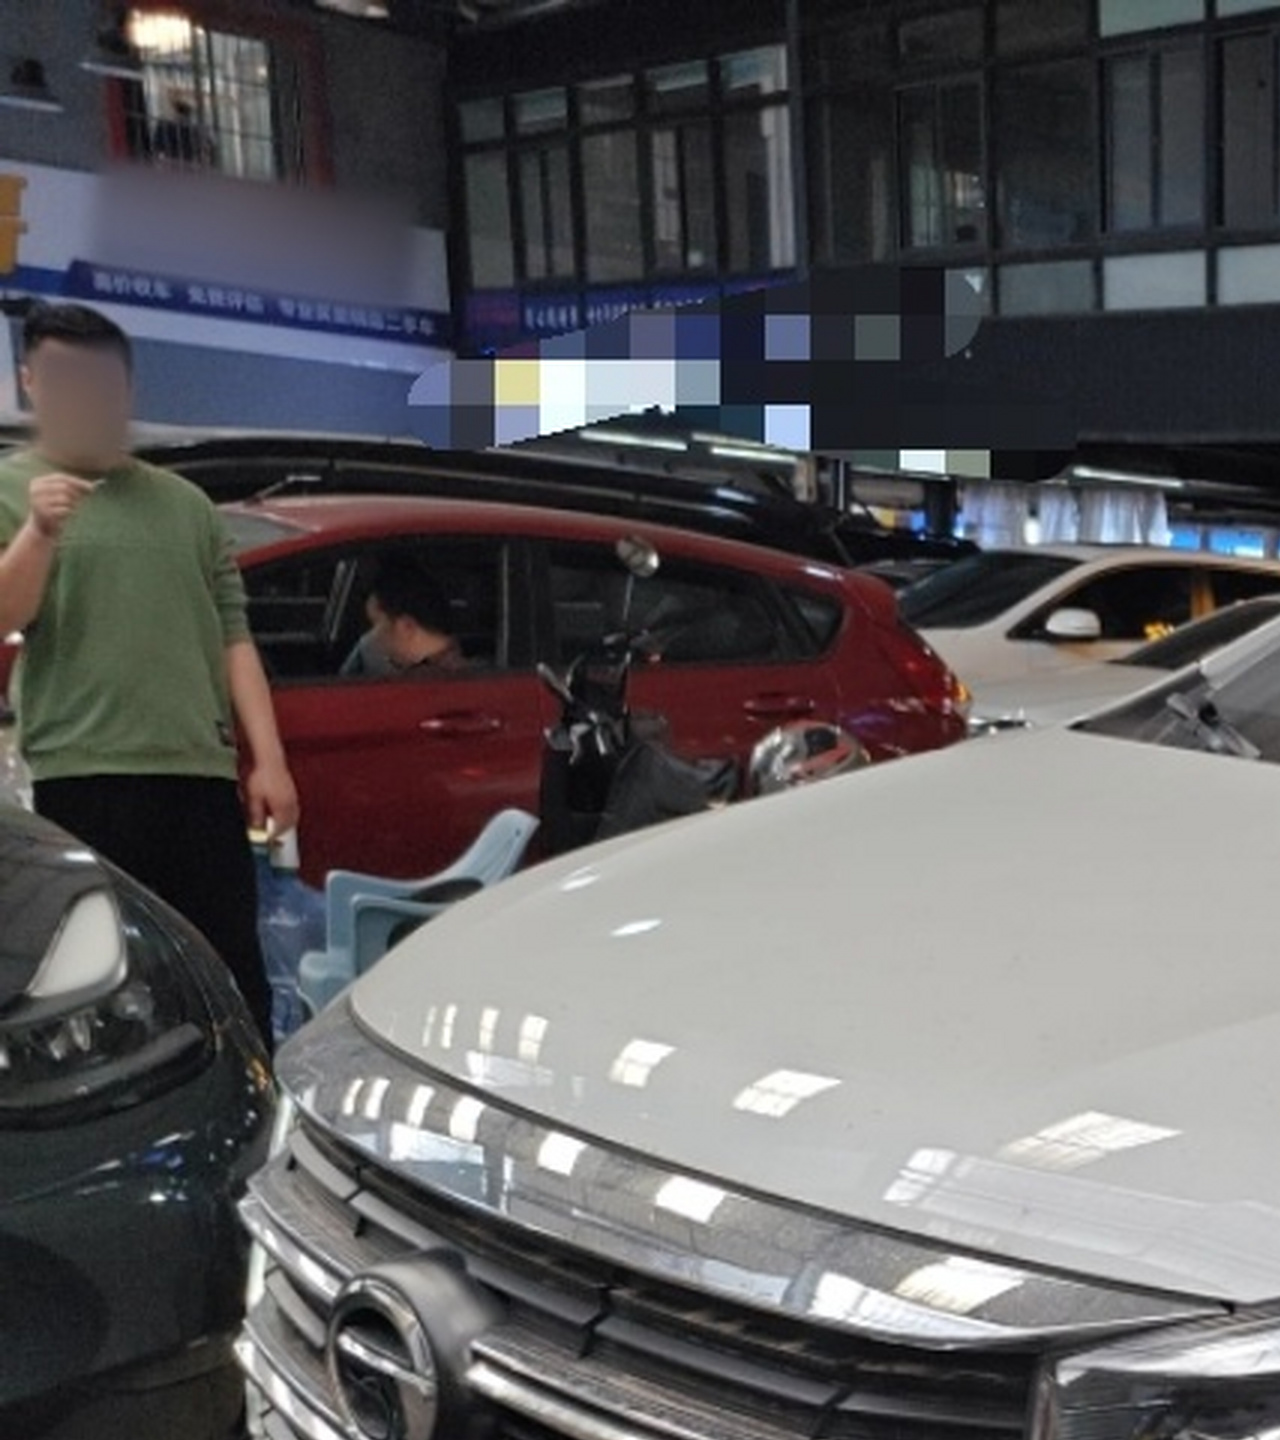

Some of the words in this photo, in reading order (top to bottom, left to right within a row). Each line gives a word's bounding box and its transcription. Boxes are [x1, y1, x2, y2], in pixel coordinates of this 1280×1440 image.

[93, 271, 172, 299] 高价收车
[188, 285, 265, 314] 免费评估
